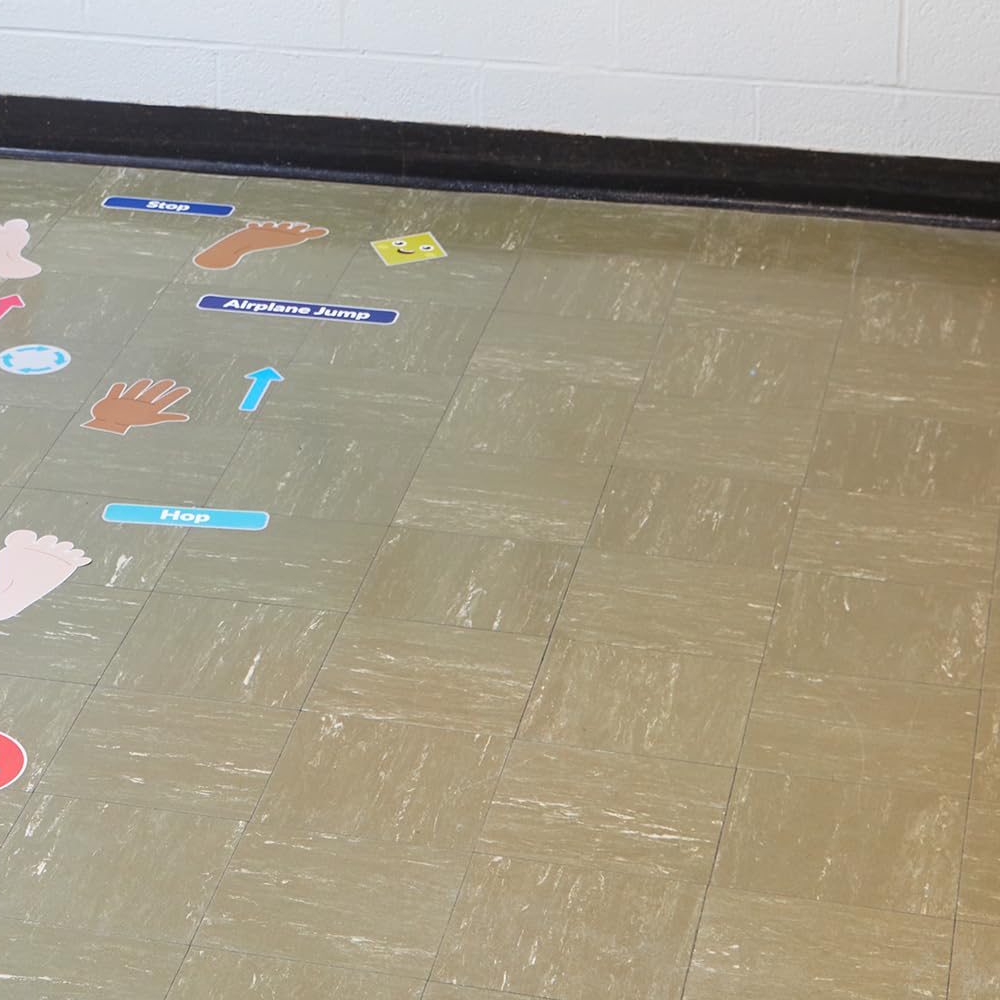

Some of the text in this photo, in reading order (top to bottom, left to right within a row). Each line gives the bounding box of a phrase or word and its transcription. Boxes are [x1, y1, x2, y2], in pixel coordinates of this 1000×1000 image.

[145, 200, 191, 212] Stop
[223, 299, 371, 321] Airplane Jump
[160, 509, 211, 524] Hop
